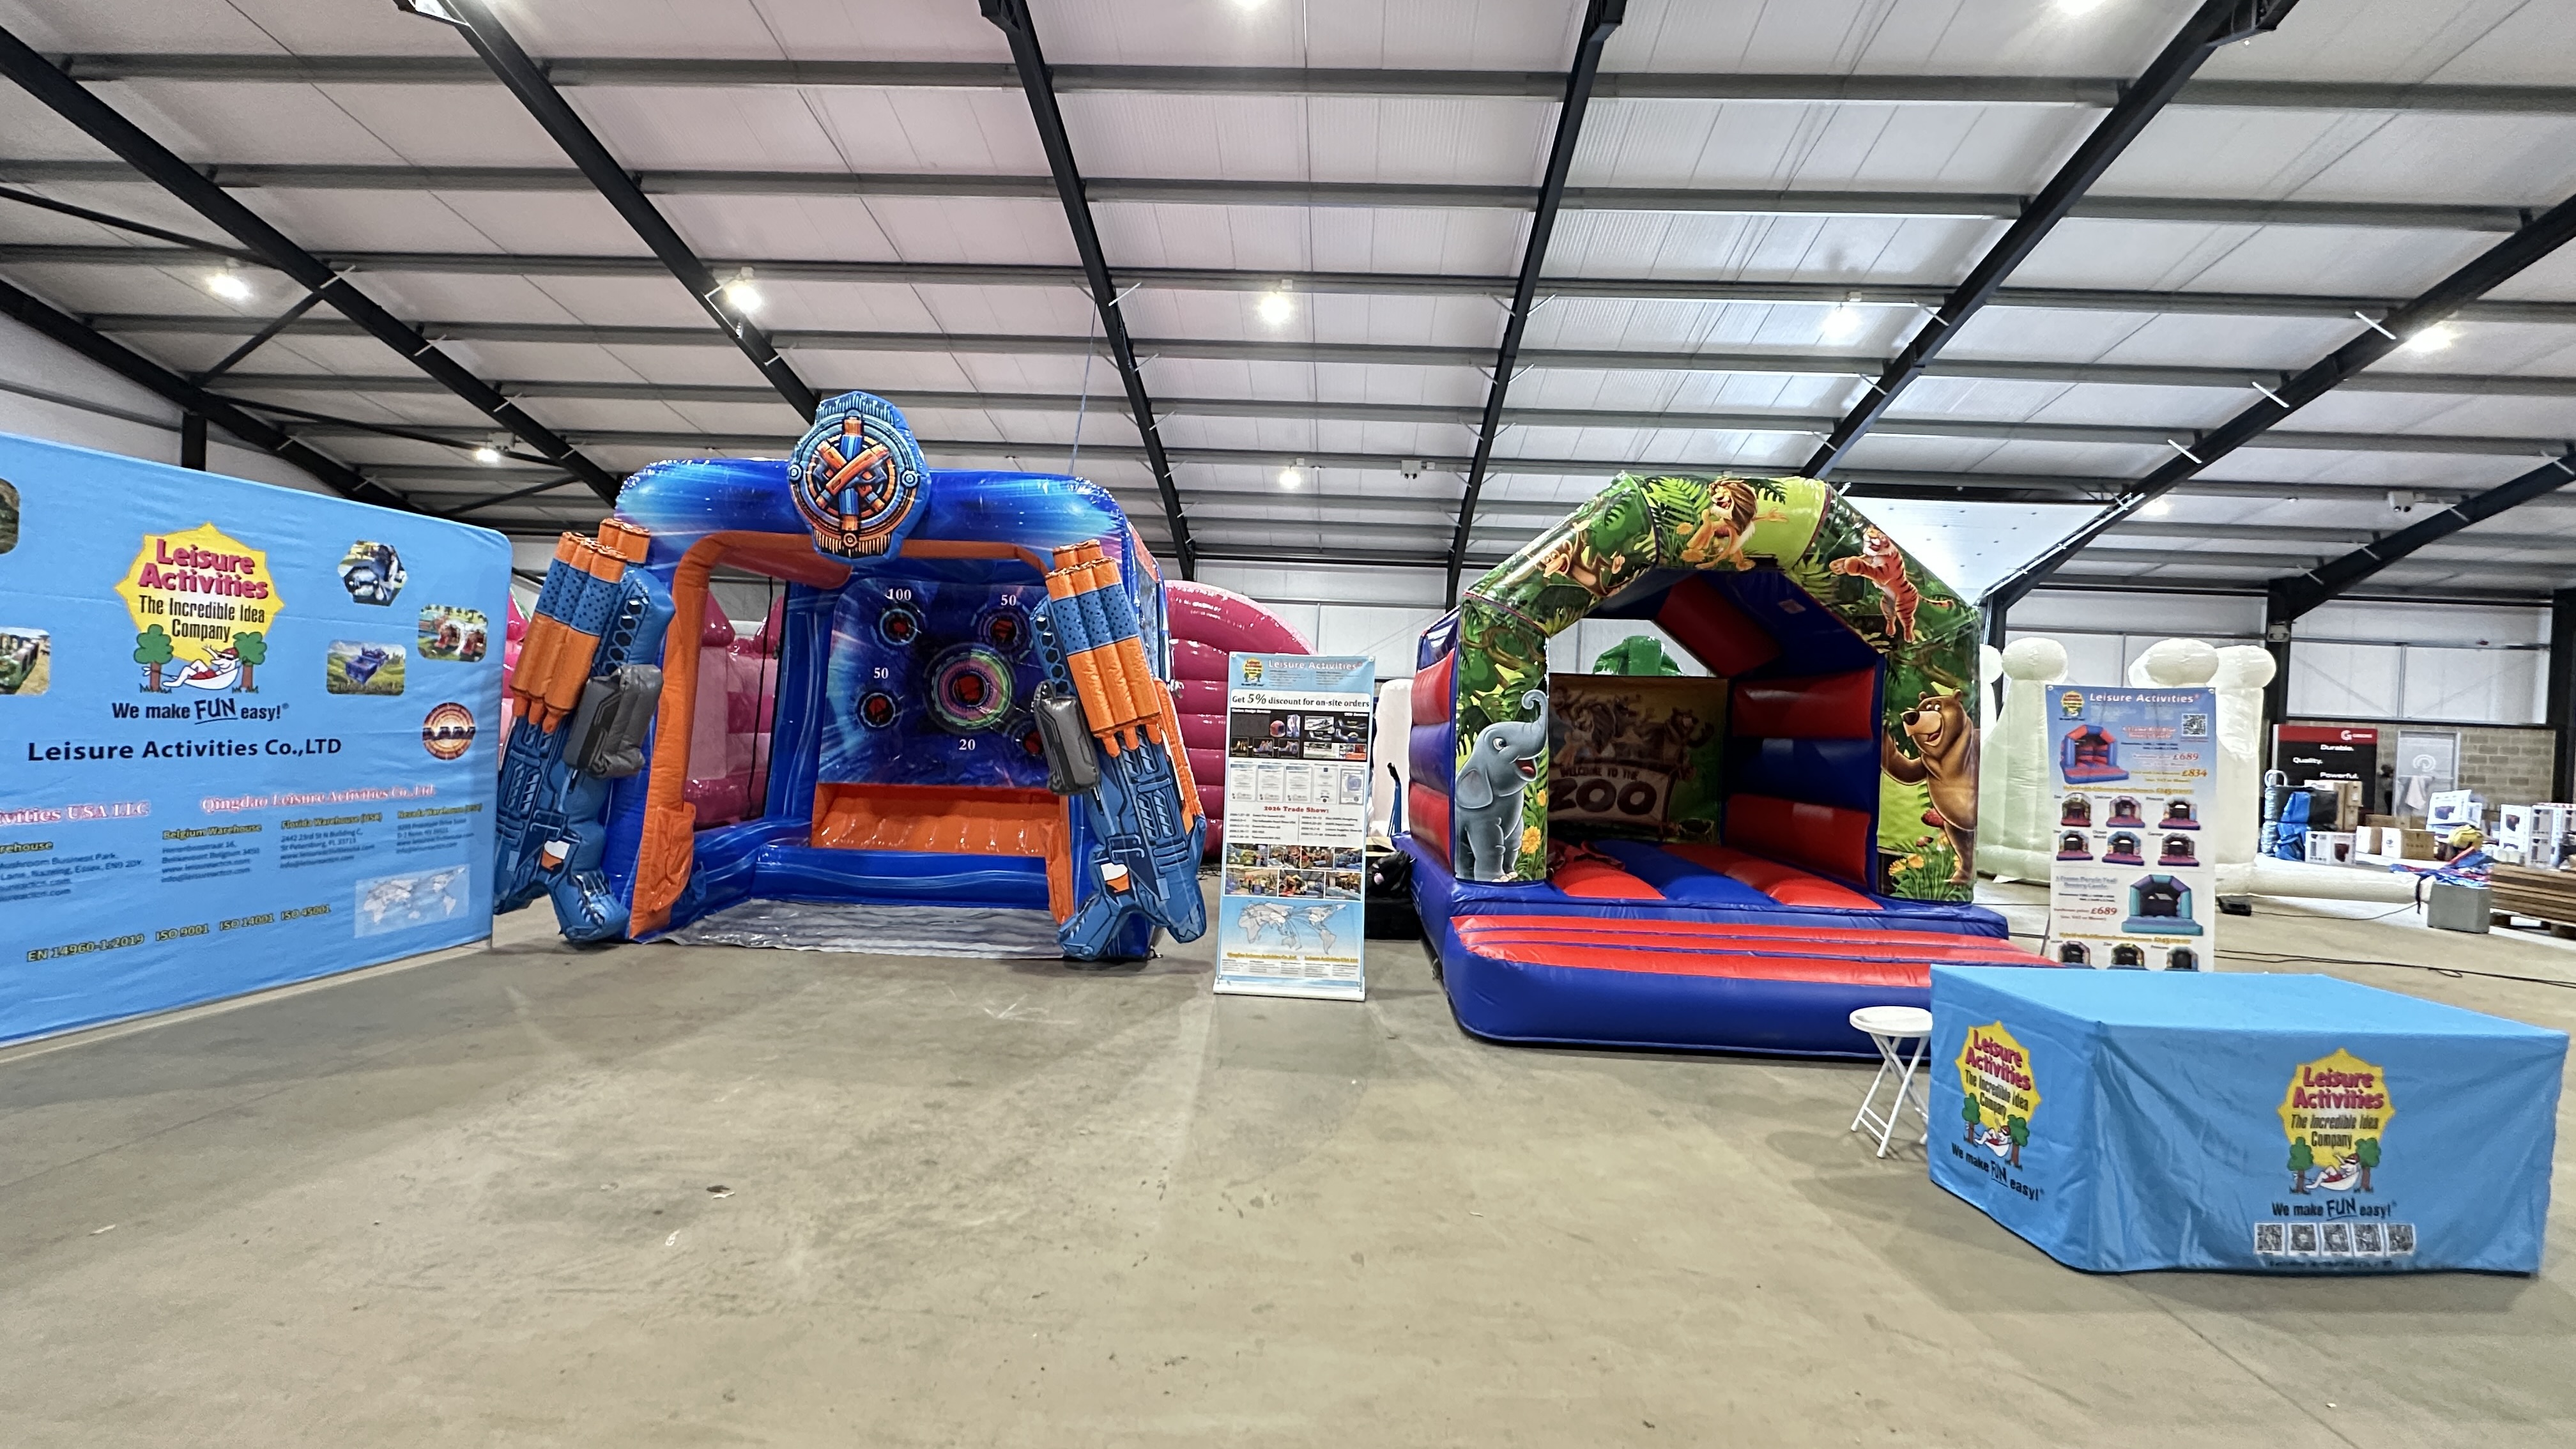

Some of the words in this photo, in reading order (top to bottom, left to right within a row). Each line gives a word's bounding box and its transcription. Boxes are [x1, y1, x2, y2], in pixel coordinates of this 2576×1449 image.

[157, 539, 255, 574] Leisure
[138, 562, 268, 599] Activities
[887, 588, 912, 601] 100
[1000, 594, 1016, 606] 50
[139, 595, 163, 615] The
[169, 597, 234, 620] Incredible
[240, 604, 264, 623] Idea
[172, 618, 230, 643] Company
[873, 667, 889, 679] 50
[1269, 660, 1305, 670] Leisure
[1247, 693, 1266, 704] 5%
[1268, 697, 1301, 705] discount
[1303, 698, 1314, 706] for
[2090, 693, 2132, 702] Leisure
[2136, 694, 2194, 703] Activities
[112, 703, 139, 719] We
[146, 703, 190, 719] make
[194, 698, 236, 720] FUN
[28, 742, 134, 761] Leisure
[142, 740, 257, 759] Activities
[265, 738, 342, 757] Co.,LTD
[959, 739, 976, 751] 20
[2182, 769, 2207, 777] £834
[201, 795, 268, 814] Qingdao
[272, 792, 325, 806] Leisure
[328, 788, 388, 803] Activities
[1549, 778, 1657, 815] ZOO
[67, 804, 107, 820] USA
[163, 828, 206, 840] Belgium
[208, 824, 263, 836] Warehouse
[281, 909, 299, 921] ISO
[2091, 907, 2117, 916] £689
[155, 930, 178, 941] ISO
[180, 923, 210, 938] 9001
[220, 919, 240, 931] ISO
[241, 913, 275, 927] 14001
[27, 949, 48, 962] EN
[50, 933, 145, 958] 14960-1:2019
[1974, 1030, 2022, 1068] Leisure
[1965, 1046, 2031, 1091] Activities
[2303, 1066, 2374, 1087] Leisure
[1965, 1070, 1977, 1087] The
[1979, 1075, 2011, 1103] Incredible
[2012, 1091, 2028, 1111] Idea
[2293, 1087, 2384, 1109] Activities
[1980, 1092, 2007, 1120] Company
[2291, 1114, 2308, 1129] The
[2310, 1114, 2356, 1129] Incredible
[2359, 1114, 2379, 1129] Idea
[2312, 1131, 2352, 1149] Company
[1952, 1142, 1963, 1159] We
[1966, 1150, 1989, 1172] make
[1990, 1160, 2007, 1183] FUN
[2272, 1201, 2289, 1216] We
[2294, 1202, 2323, 1216] make
[2326, 1197, 2356, 1217] FUN
